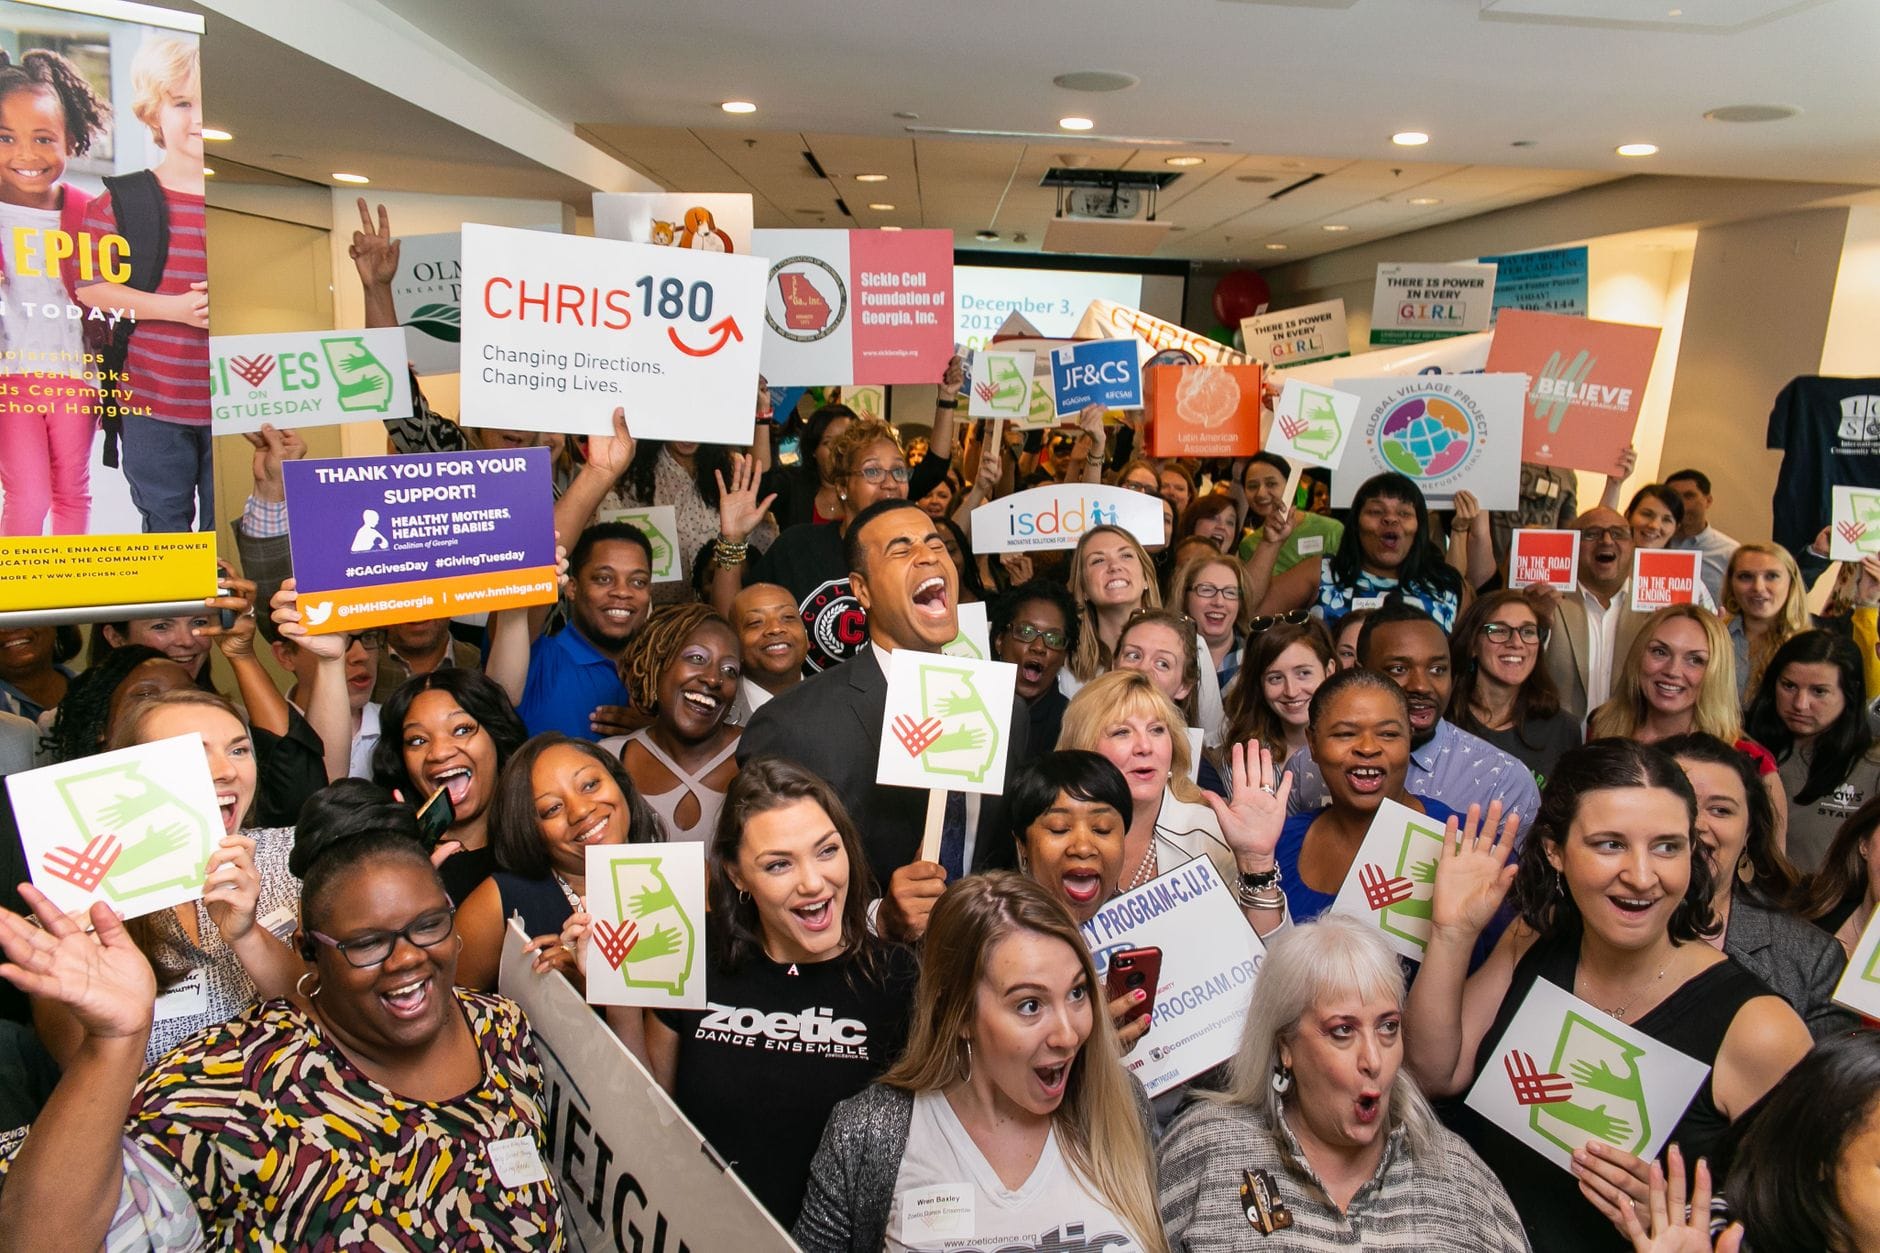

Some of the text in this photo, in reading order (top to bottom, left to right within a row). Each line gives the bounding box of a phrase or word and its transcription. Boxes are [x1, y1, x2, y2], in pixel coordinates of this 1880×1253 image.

[12, 226, 132, 284] EPIC
[861, 272, 926, 287] Sickle Cell
[1387, 277, 1484, 288] THERE IS POWER
[861, 291, 945, 306] Foundation of
[1407, 289, 1461, 299] IN EVERY
[21, 301, 137, 324] TODAY!
[961, 295, 1074, 317] December 3,
[862, 310, 938, 326] Georgia, Inc.
[960, 314, 1004, 330] 2019
[1254, 323, 1284, 335] THERE
[1285, 319, 1296, 329] IS
[1298, 312, 1332, 326] POWER
[1272, 325, 1316, 341] IN EVERY
[483, 344, 666, 376] Changing Directions.
[482, 367, 623, 394] Changing Lives.
[1062, 360, 1130, 391] JF&CS
[28, 384, 134, 401] Ceremony
[248, 391, 268, 400] ON
[1538, 377, 1633, 409] BELIEVE
[65, 402, 152, 417] Hangout
[214, 398, 322, 420] GTUESDAY
[1366, 382, 1488, 437] GLOBAL VILLAGE PROJECT
[1178, 432, 1239, 442] Latin American
[1184, 444, 1232, 453] Association
[315, 457, 527, 484] THANK YOU FOR YOUR
[1422, 472, 1464, 489] REFUGEE
[1465, 448, 1482, 472] GIRLS
[383, 484, 476, 505] SUPPORT!
[391, 508, 511, 528] HEALTHY MOTHERS,
[1009, 496, 1086, 536] isdd
[392, 521, 495, 540] HEALTHY BABIES
[67, 545, 122, 553] ENHANCE
[154, 543, 209, 551] EMPOWER
[393, 538, 459, 551] Coalition of Georgia
[1007, 537, 1031, 546] INNOVATIVE
[1032, 537, 1057, 545] SOLUTIONS
[70, 556, 93, 564] THE
[97, 555, 165, 563] COMMUNITY
[345, 550, 526, 578] #GAGivesDay #GivingTuesday
[1516, 555, 1571, 570] ON THE ROAD
[47, 570, 139, 579] WWW.EPICHSN.COM
[1515, 567, 1550, 581] LENDING
[1637, 576, 1693, 591] ON THE ROAD
[337, 582, 552, 617] @HMHBGeorgia www.hmhbga.org
[1637, 588, 1671, 602] LENDING
[803, 585, 845, 622] COL
[838, 609, 866, 645] C
[1079, 864, 1219, 949] TY PROGRAM-C.U.P.
[786, 963, 800, 976] A
[699, 1001, 868, 1045] zoetic
[694, 1028, 868, 1056] DANCE ENSEMBLE
[917, 1194, 961, 1206] Wren Baxley
[907, 1212, 923, 1221] Zoetic
[924, 1209, 942, 1217] Dance
[944, 1232, 1037, 1248] www.zoeticdance.org
